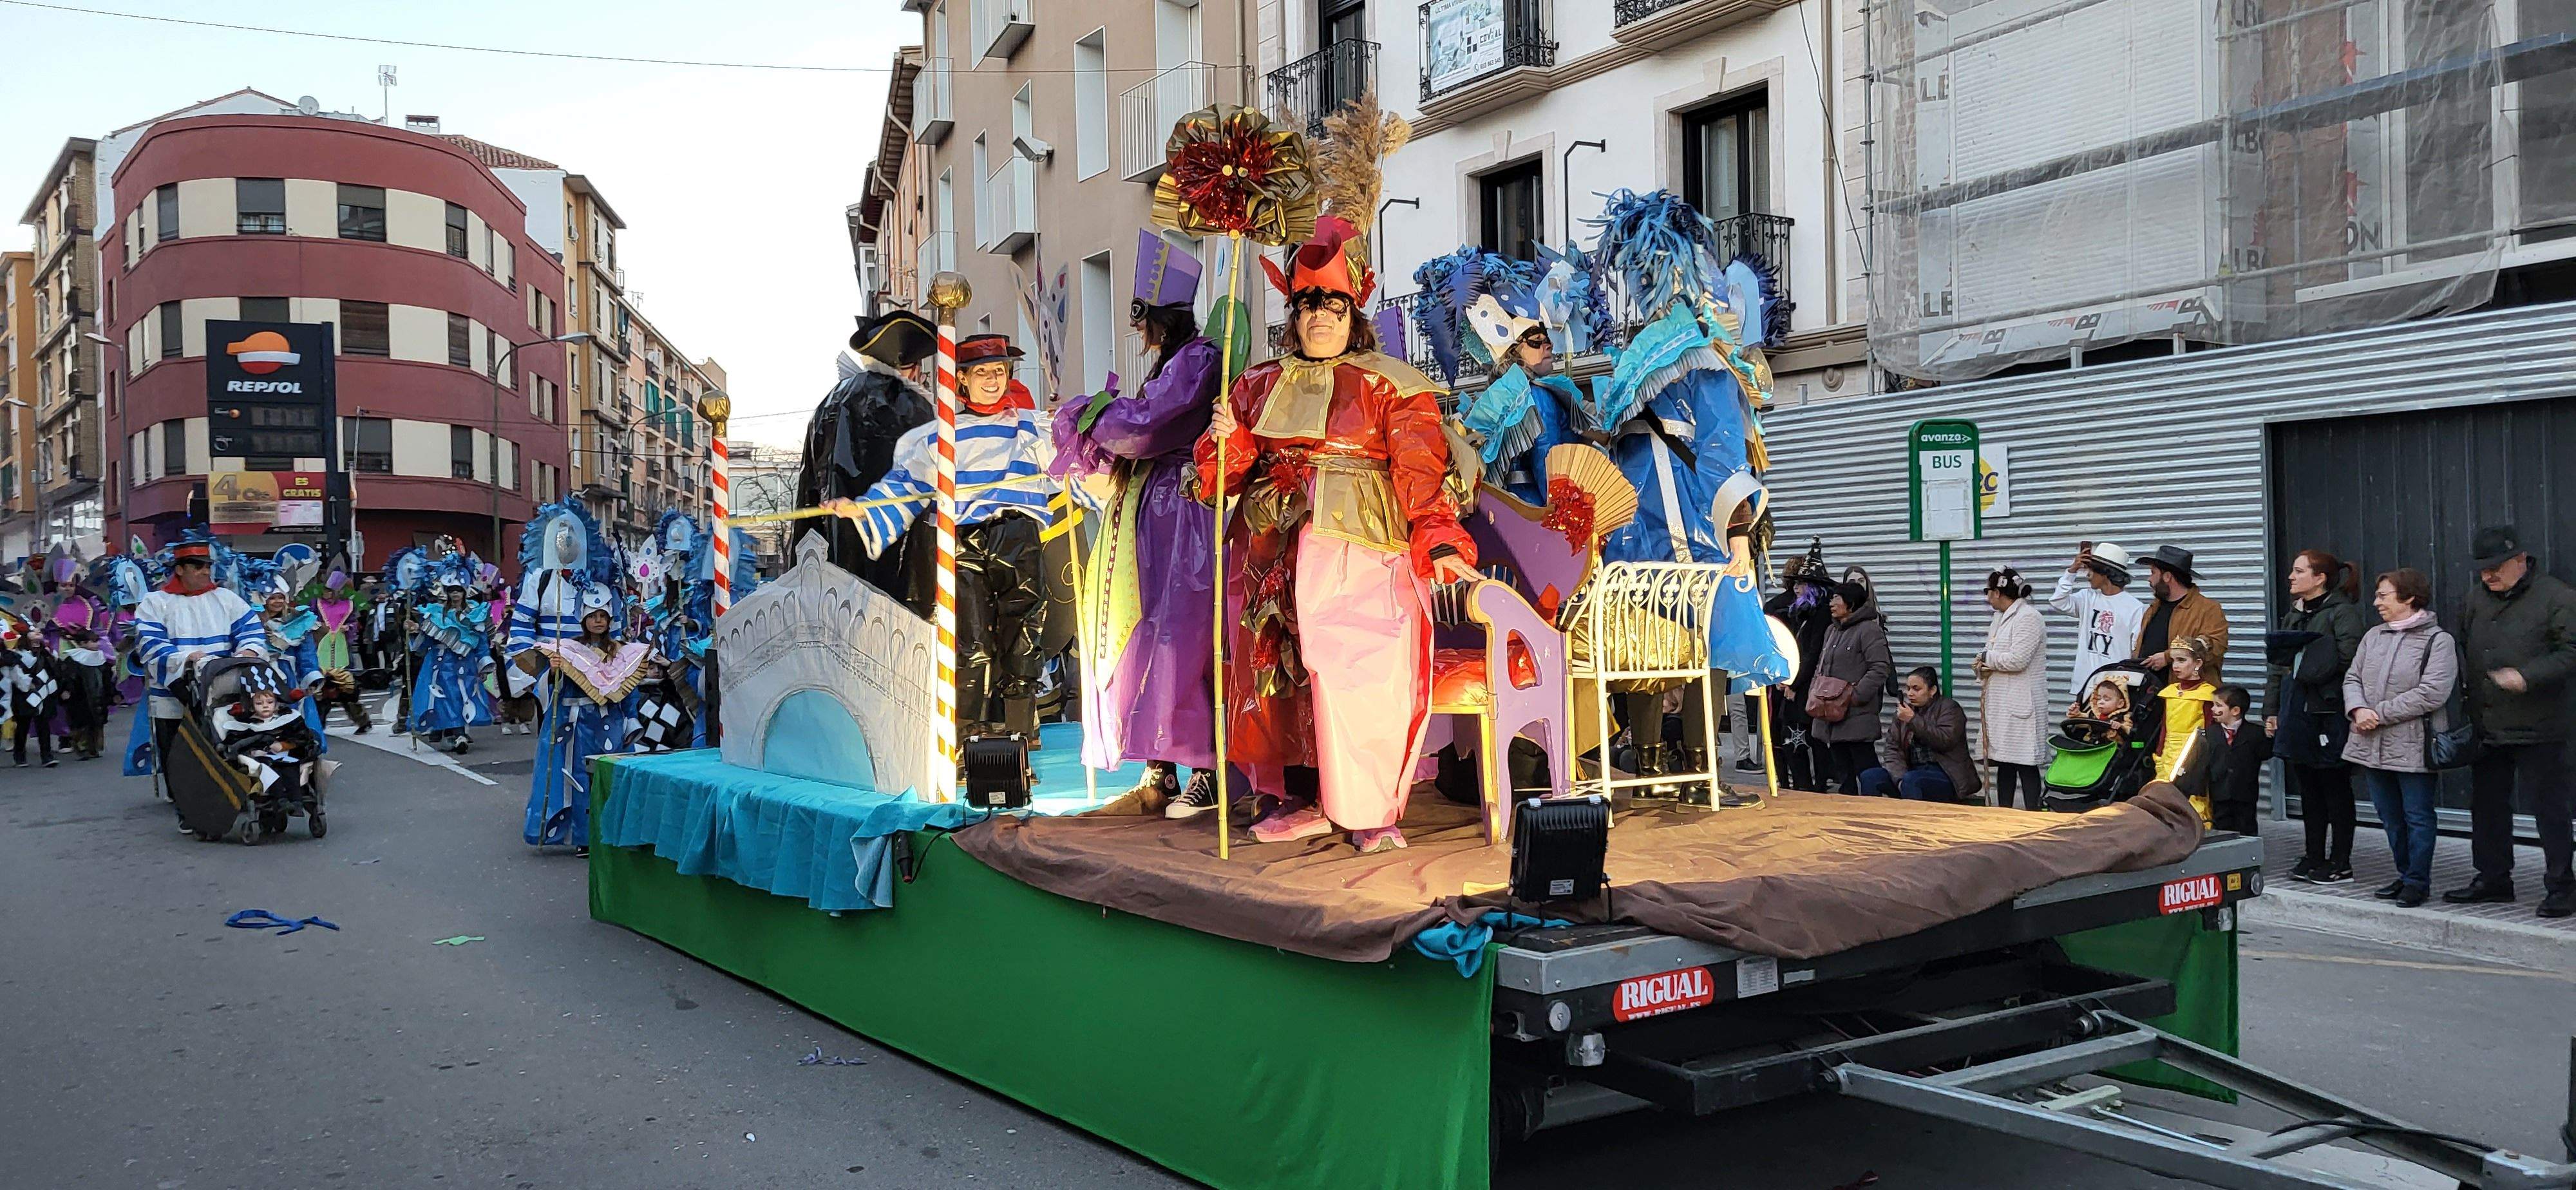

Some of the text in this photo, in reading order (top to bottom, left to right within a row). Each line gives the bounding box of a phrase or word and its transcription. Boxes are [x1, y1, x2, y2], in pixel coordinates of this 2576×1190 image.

[227, 380, 303, 393] REPSOL
[1920, 433, 1961, 442] avanza
[1932, 455, 1962, 469] BUS
[212, 474, 241, 501] 4
[295, 477, 309, 486] ES
[283, 488, 323, 498] GRATIS
[2091, 609, 2100, 628] I
[2164, 876, 2219, 907] RIGUAL
[1621, 970, 1709, 1010] RIGUAL
